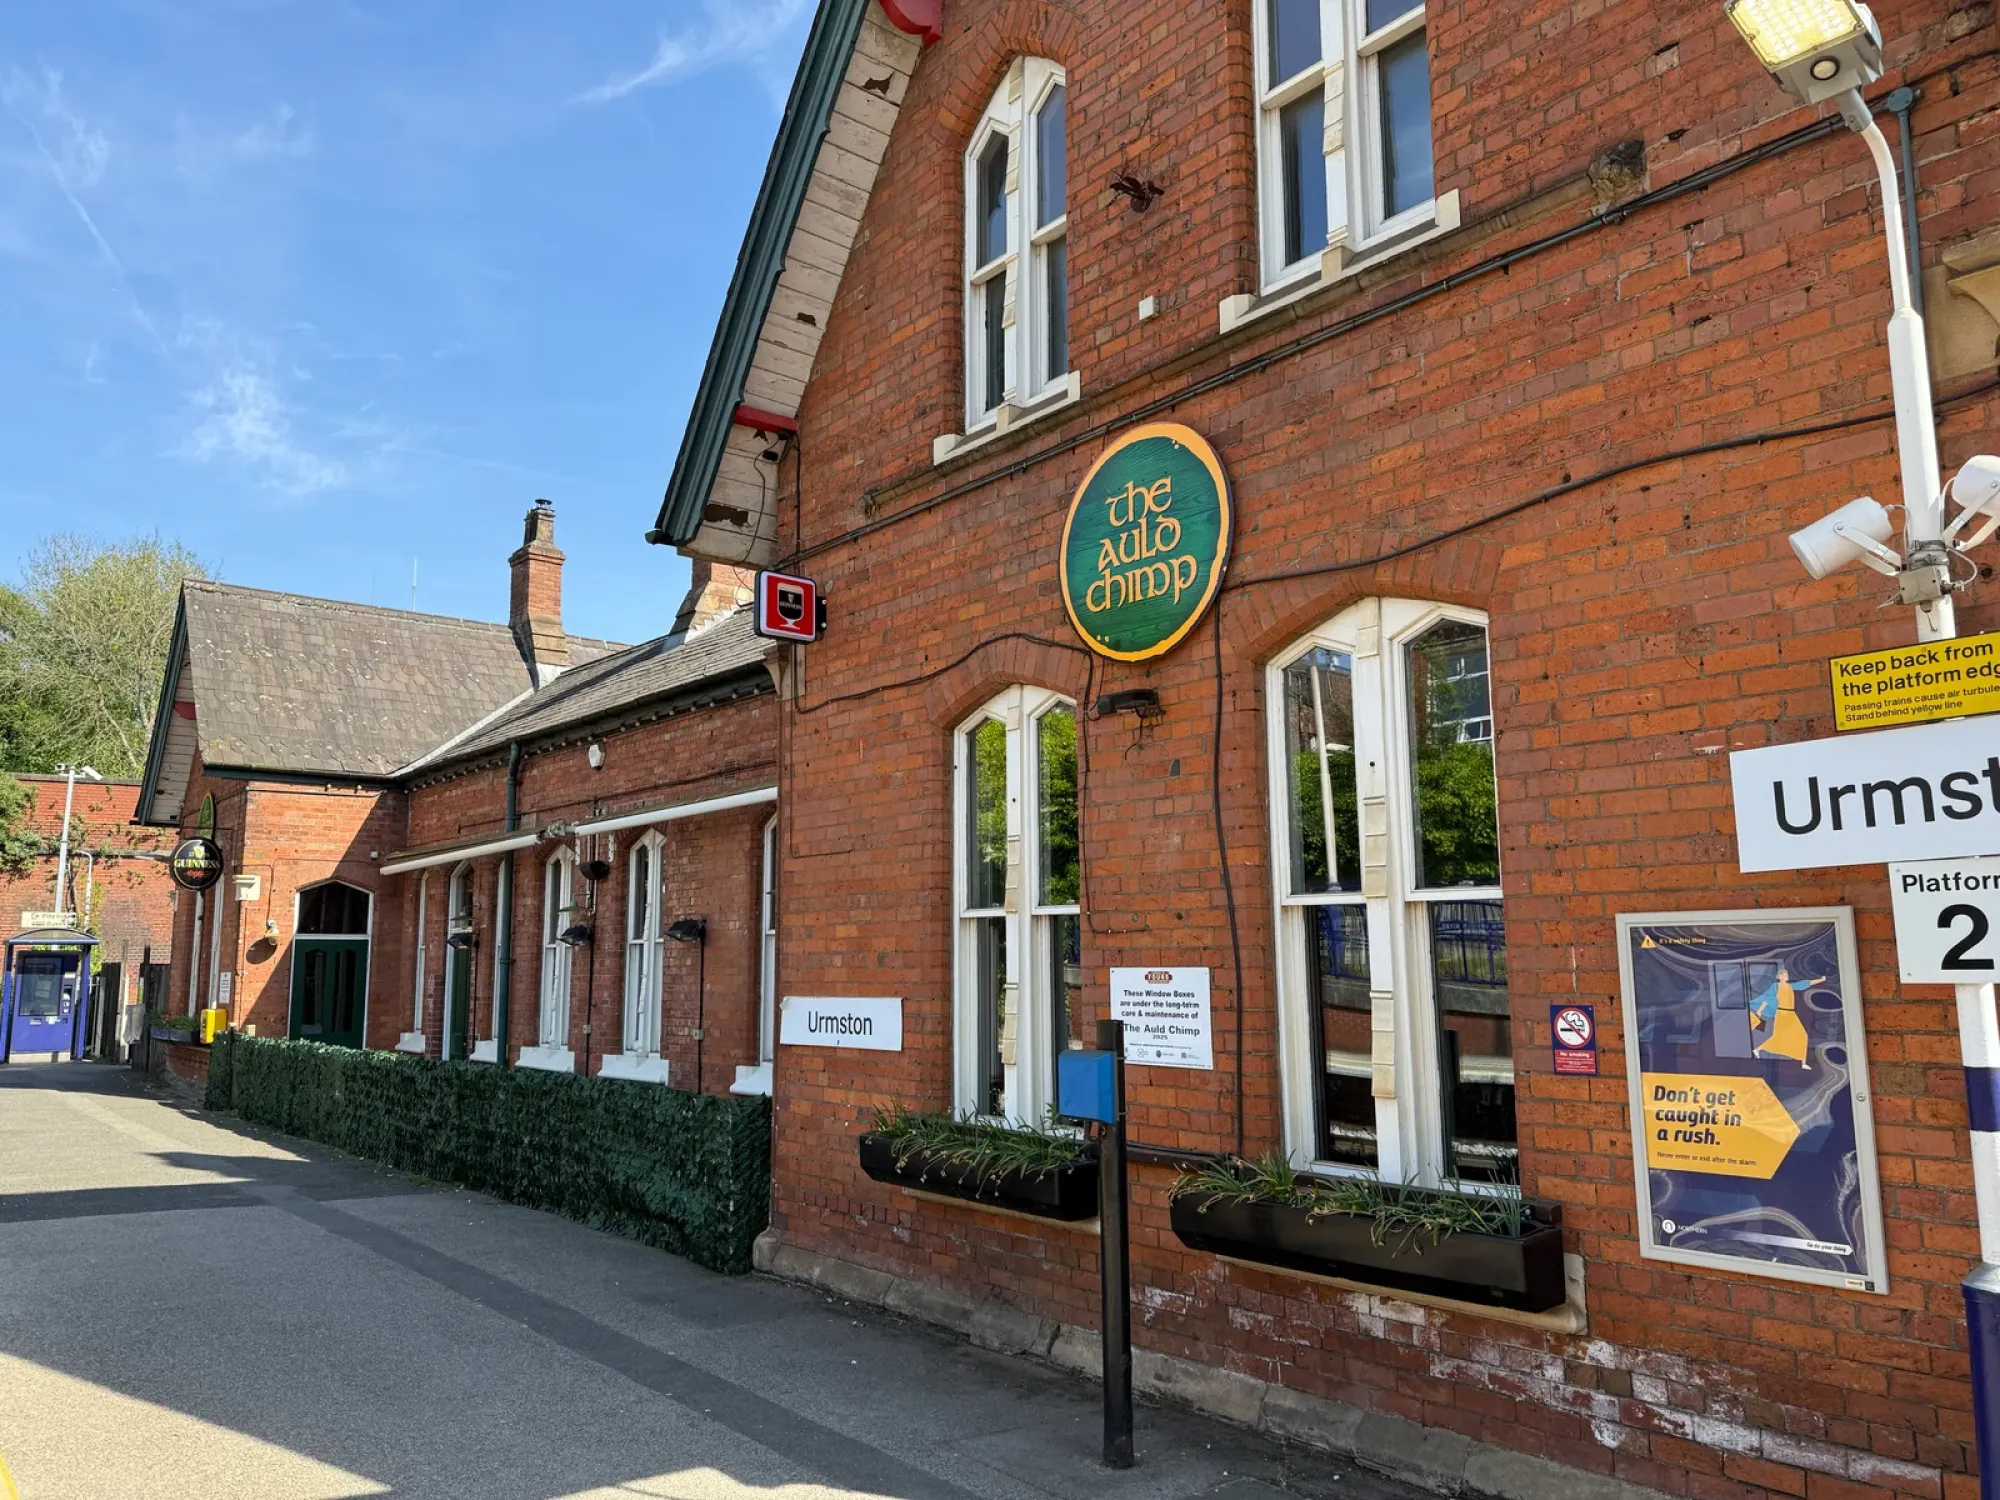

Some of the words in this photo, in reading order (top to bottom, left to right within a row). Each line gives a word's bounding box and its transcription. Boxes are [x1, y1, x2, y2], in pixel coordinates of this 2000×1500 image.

[1839, 660, 1886, 677] Keep
[1890, 649, 1940, 670] back
[1944, 642, 1993, 661] from
[1842, 682, 1872, 697] the
[1877, 668, 1961, 695] platform
[1844, 701, 1882, 712] Passing
[1884, 696, 1912, 706] trains
[1914, 692, 1945, 702] cause
[1947, 689, 1960, 698] air
[1845, 710, 1875, 722] Stand
[1875, 707, 1910, 718] behind
[1910, 703, 1942, 715] yellow
[1944, 700, 1963, 710] line
[174, 859, 221, 868] GUINNESS
[1937, 903, 1995, 970] 2
[1123, 989, 1143, 997] These
[1173, 990, 1195, 998] Boxes
[1145, 1010, 1189, 1018] maintenance
[1153, 1000, 1164, 1008] the
[1165, 1001, 1199, 1009] long-term
[808, 1011, 872, 1035] Urmston
[1124, 1024, 1140, 1032] The
[1144, 1024, 1166, 1033] Auld
[1168, 1025, 1200, 1036] Chimp
[1653, 1084, 1700, 1104] Don't
[1705, 1090, 1736, 1108] get
[1655, 1106, 1719, 1127] caught
[1724, 1110, 1741, 1126] in
[1657, 1128, 1668, 1141] a
[1673, 1128, 1721, 1146] rush.
[1712, 1155, 1726, 1163] after
[1833, 1245, 1847, 1253] thing
